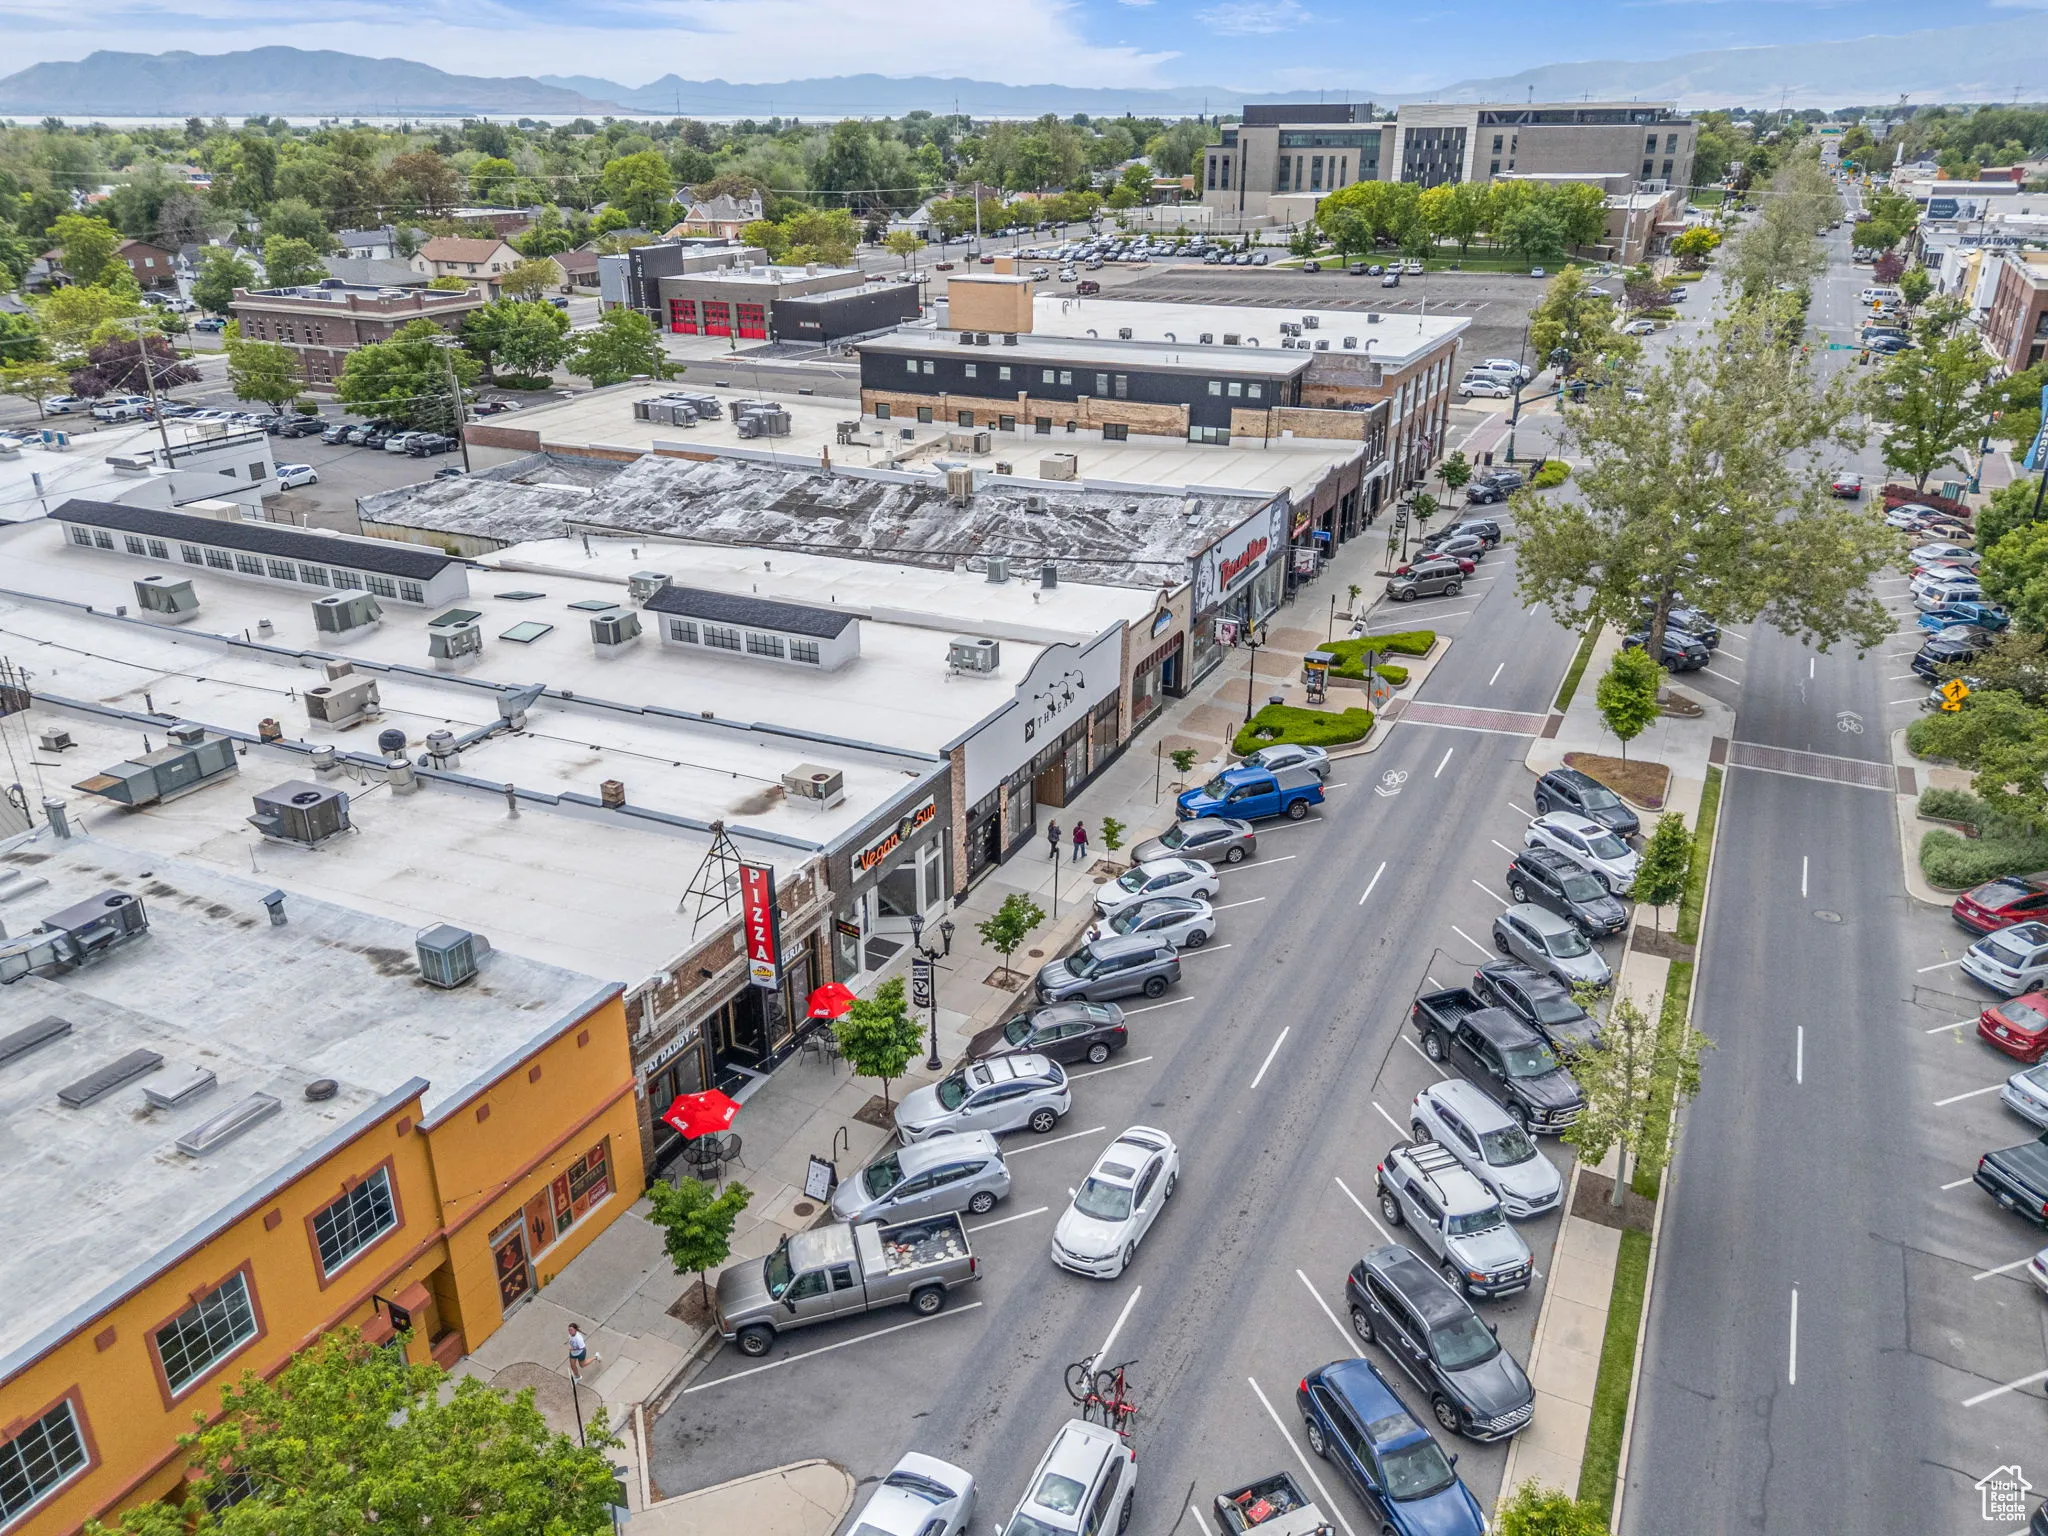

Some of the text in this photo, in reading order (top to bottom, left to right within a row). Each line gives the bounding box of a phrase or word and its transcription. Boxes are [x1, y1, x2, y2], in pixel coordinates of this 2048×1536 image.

[859, 804, 937, 871] Vegan Sun
[748, 868, 769, 960] PIZZA
[781, 943, 804, 966] ZERIA
[660, 1027, 699, 1063] DADDY'S
